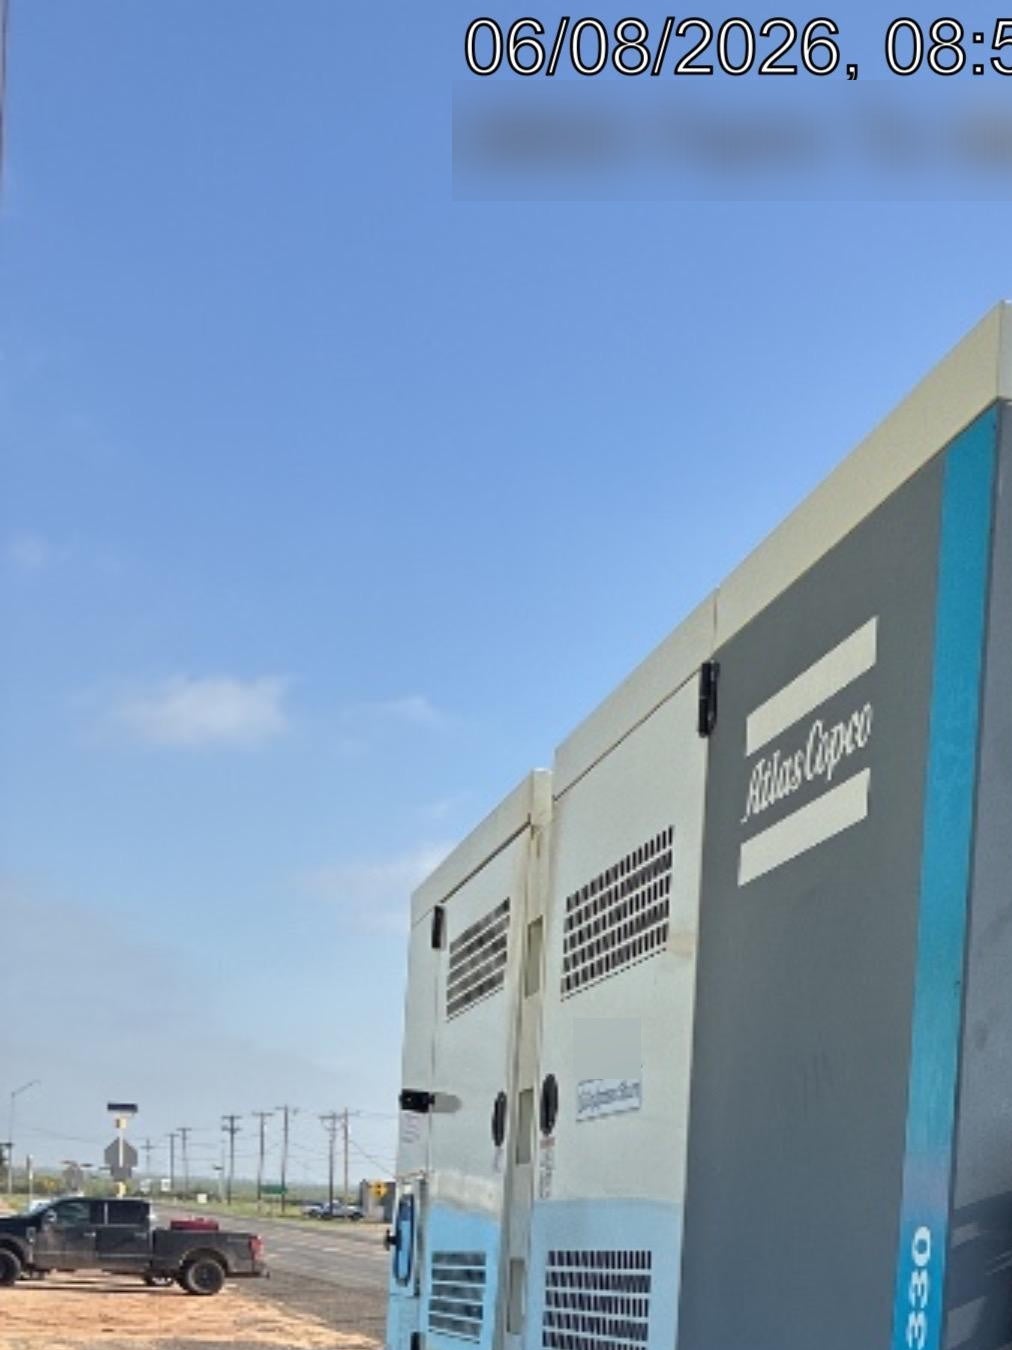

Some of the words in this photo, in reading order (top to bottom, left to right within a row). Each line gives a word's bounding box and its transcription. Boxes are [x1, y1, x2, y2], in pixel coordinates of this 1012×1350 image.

[740, 749, 803, 823] Atlas
[803, 702, 873, 781] Copco
[905, 1225, 931, 1350] 330
